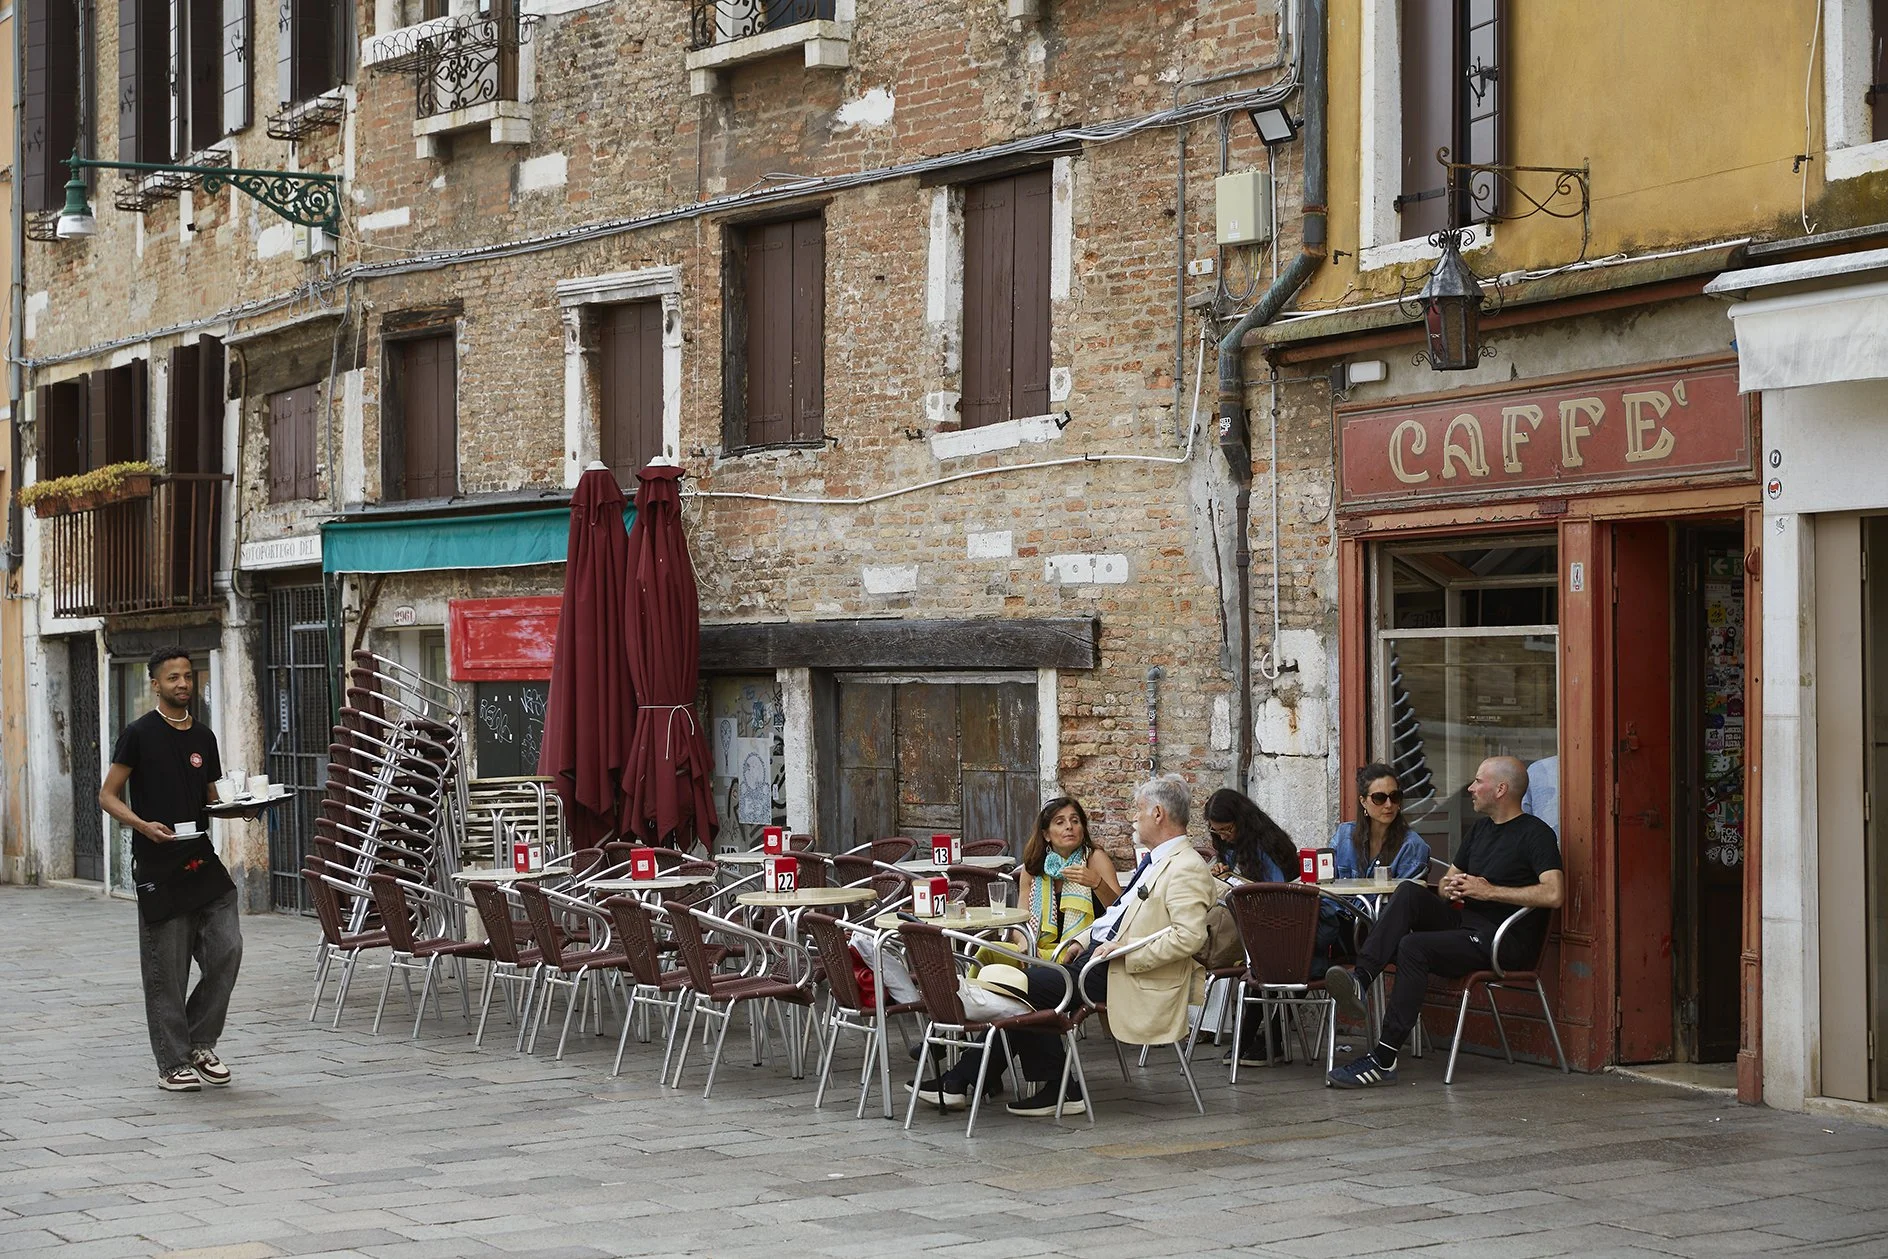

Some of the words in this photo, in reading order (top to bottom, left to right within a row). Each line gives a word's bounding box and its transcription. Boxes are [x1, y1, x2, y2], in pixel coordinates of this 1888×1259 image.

[299, 539, 315, 556] DEL
[1720, 835, 1738, 843] NZS
[1721, 828, 1738, 836] FCK
[935, 848, 948, 863] 13
[779, 873, 793, 890] 22
[934, 894, 946, 915] 21
